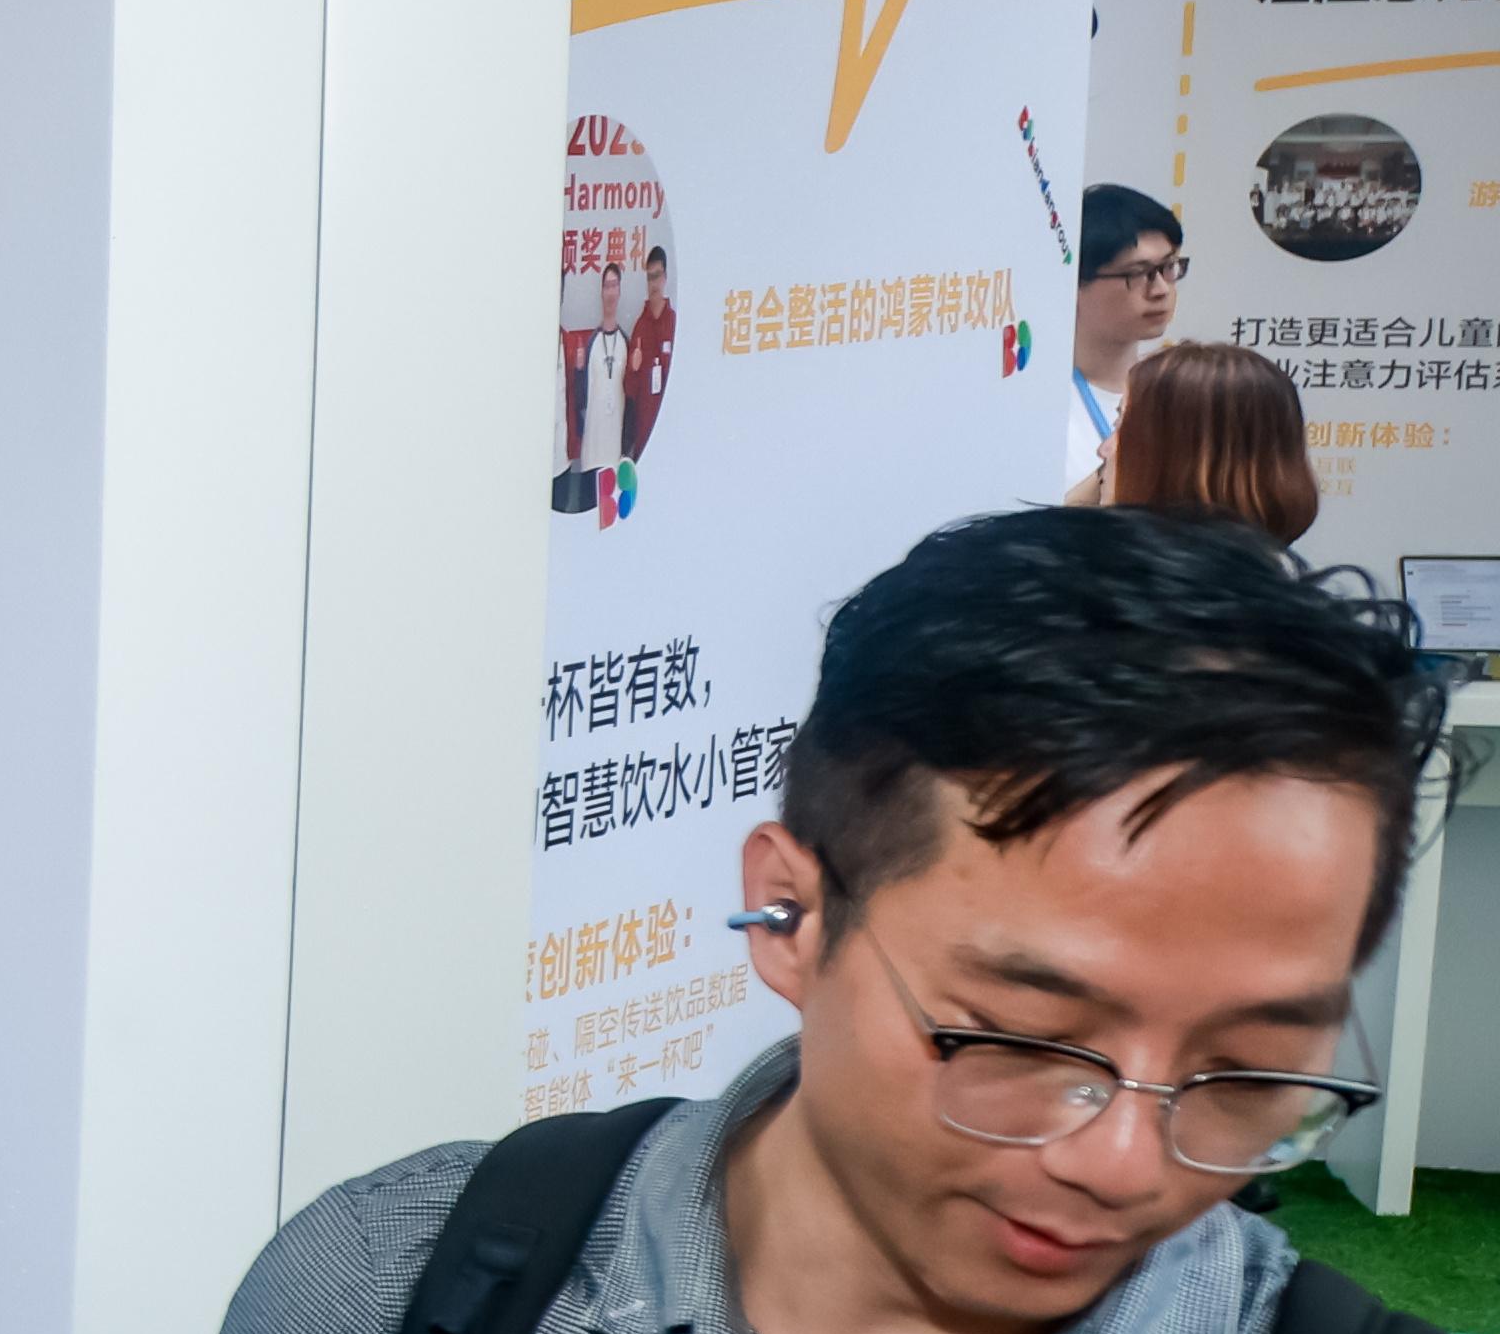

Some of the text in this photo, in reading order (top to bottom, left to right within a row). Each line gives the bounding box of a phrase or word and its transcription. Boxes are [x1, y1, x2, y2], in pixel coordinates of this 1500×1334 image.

[567, 114, 645, 156] 202
[722, 267, 1016, 356] 超会整活的鸿蒙特攻队
[1231, 316, 1500, 348] 打造更适合儿童
[1277, 358, 1500, 391] 注意力评估
[541, 634, 712, 742] 杯皆有数，
[534, 716, 800, 852] 智慧饮水小管家
[522, 963, 749, 1072] 碰、隔空传送饮品数据
